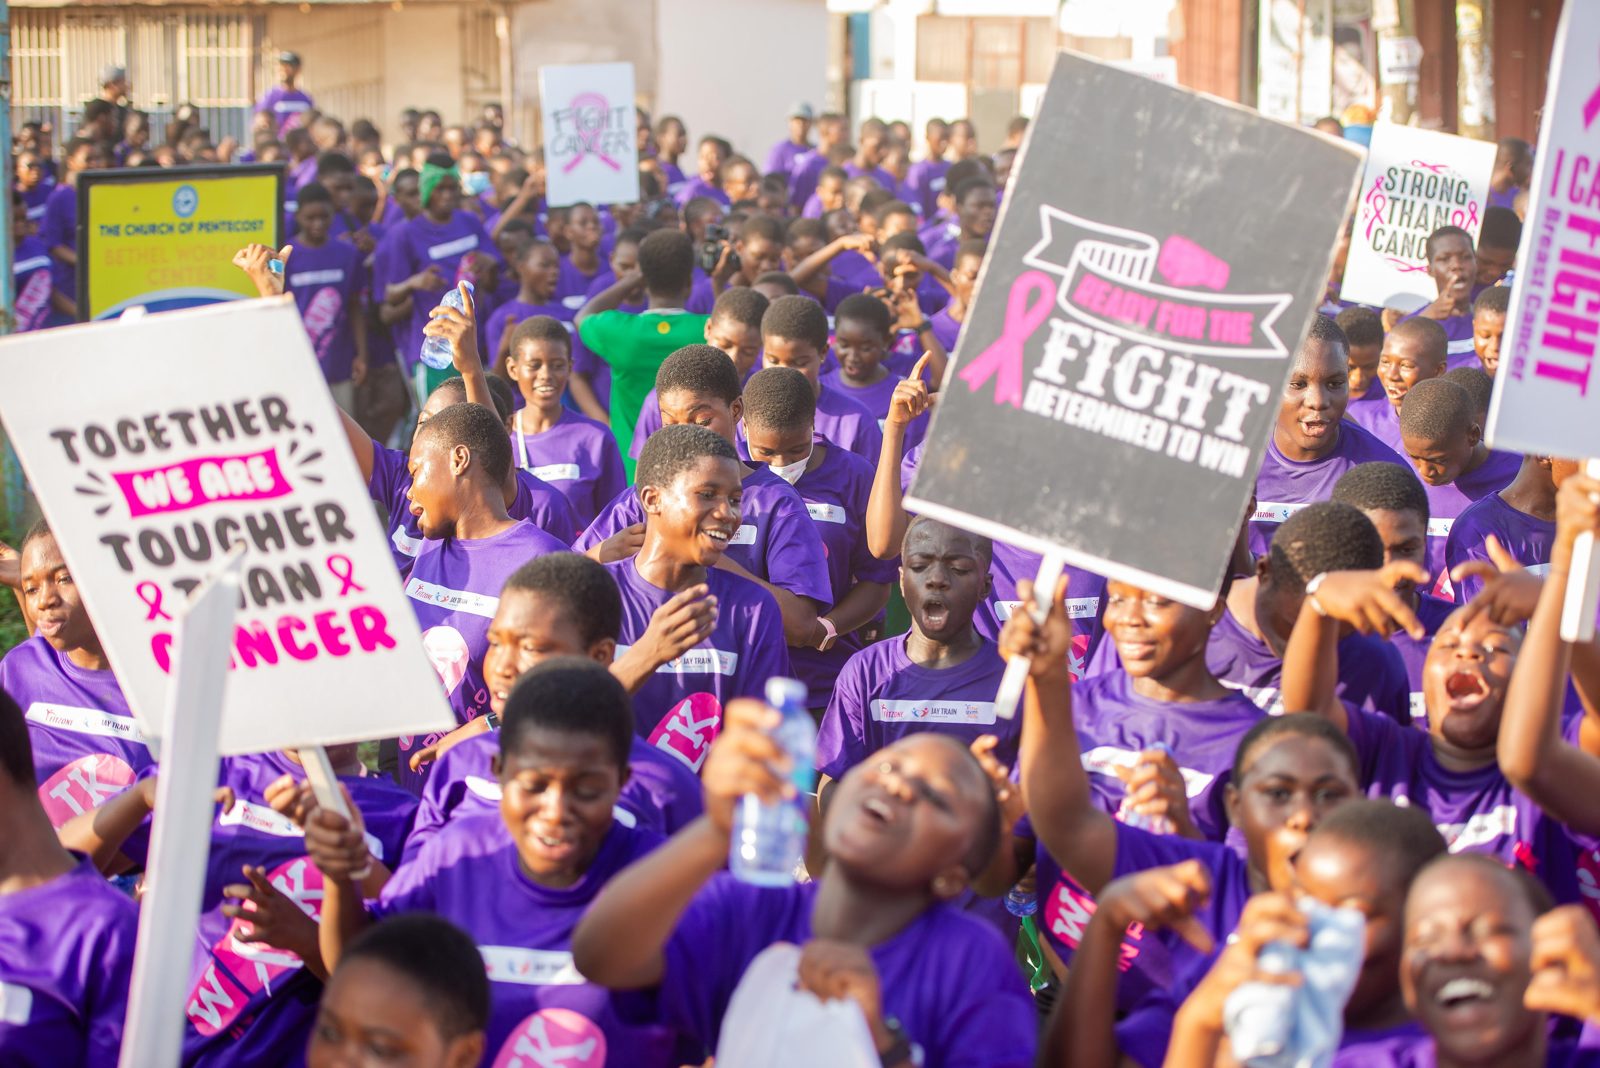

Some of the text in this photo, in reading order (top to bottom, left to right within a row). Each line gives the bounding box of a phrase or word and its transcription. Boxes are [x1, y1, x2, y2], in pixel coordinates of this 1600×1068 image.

[550, 131, 631, 157] CANCER
[552, 105, 627, 132] FIGHT
[1385, 166, 1469, 206] STRONG
[1568, 155, 1600, 211] CA
[100, 219, 264, 236] THE CHURCH OF PENTECOST
[1388, 196, 1450, 232] THAN
[105, 246, 170, 266] BETHEL
[1372, 228, 1429, 260] CANC
[1531, 206, 1562, 288] Breast
[146, 267, 217, 286] CENTER
[1073, 273, 1254, 345] READY FOR THE
[1511, 293, 1542, 381] Cancer
[1033, 318, 1270, 441] FIGHT
[50, 395, 314, 464] TOGETHER,
[1022, 380, 1250, 478] DETERMINED TO WIN
[131, 456, 276, 509] WE ARE
[99, 502, 356, 573] TOUGHER
[172, 561, 323, 612] AN
[151, 605, 397, 676] CNCER
[111, 720, 131, 732] TRAIN
[931, 707, 940, 715] JAY
[941, 707, 957, 715] TRAIN
